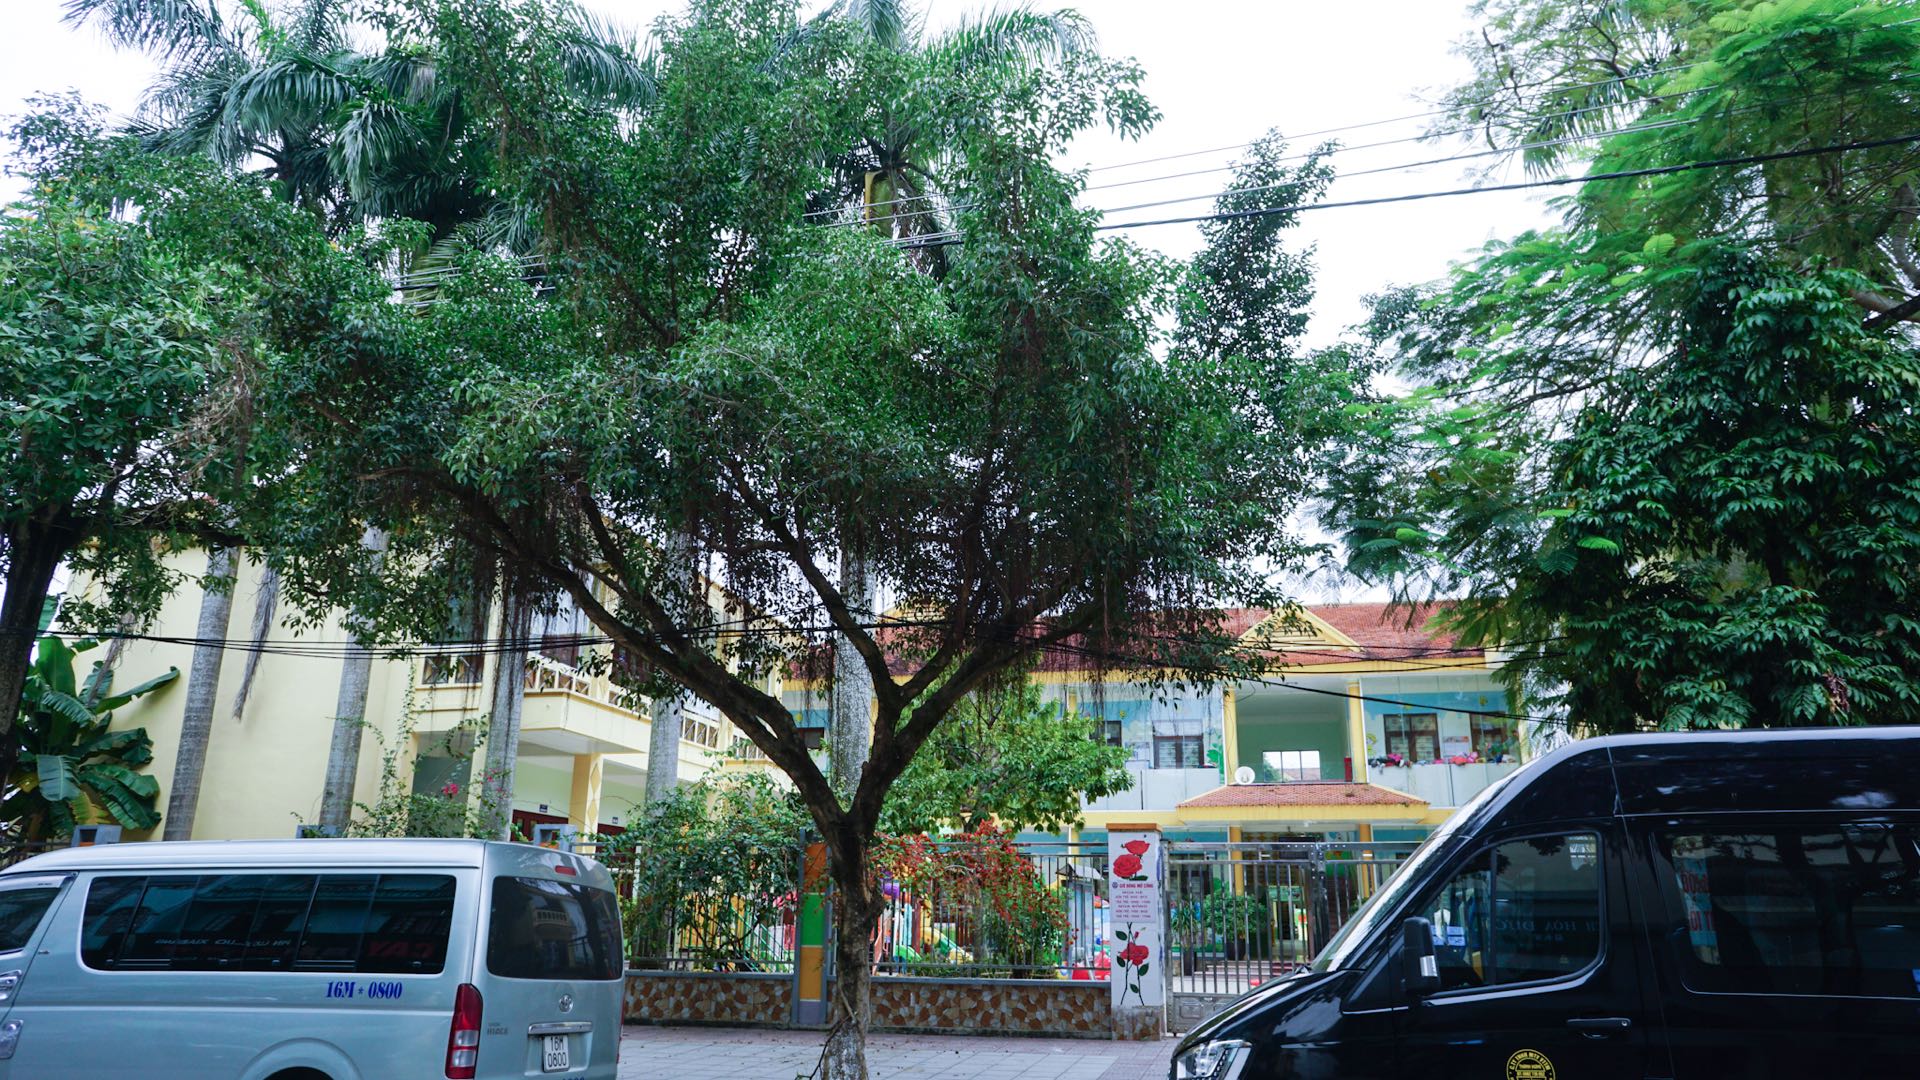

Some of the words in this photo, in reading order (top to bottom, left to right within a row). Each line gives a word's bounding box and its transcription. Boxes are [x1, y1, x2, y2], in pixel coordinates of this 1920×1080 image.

[326, 981, 356, 998] 16M
[368, 981, 403, 999] 0800
[547, 1052, 567, 1067] 0800
